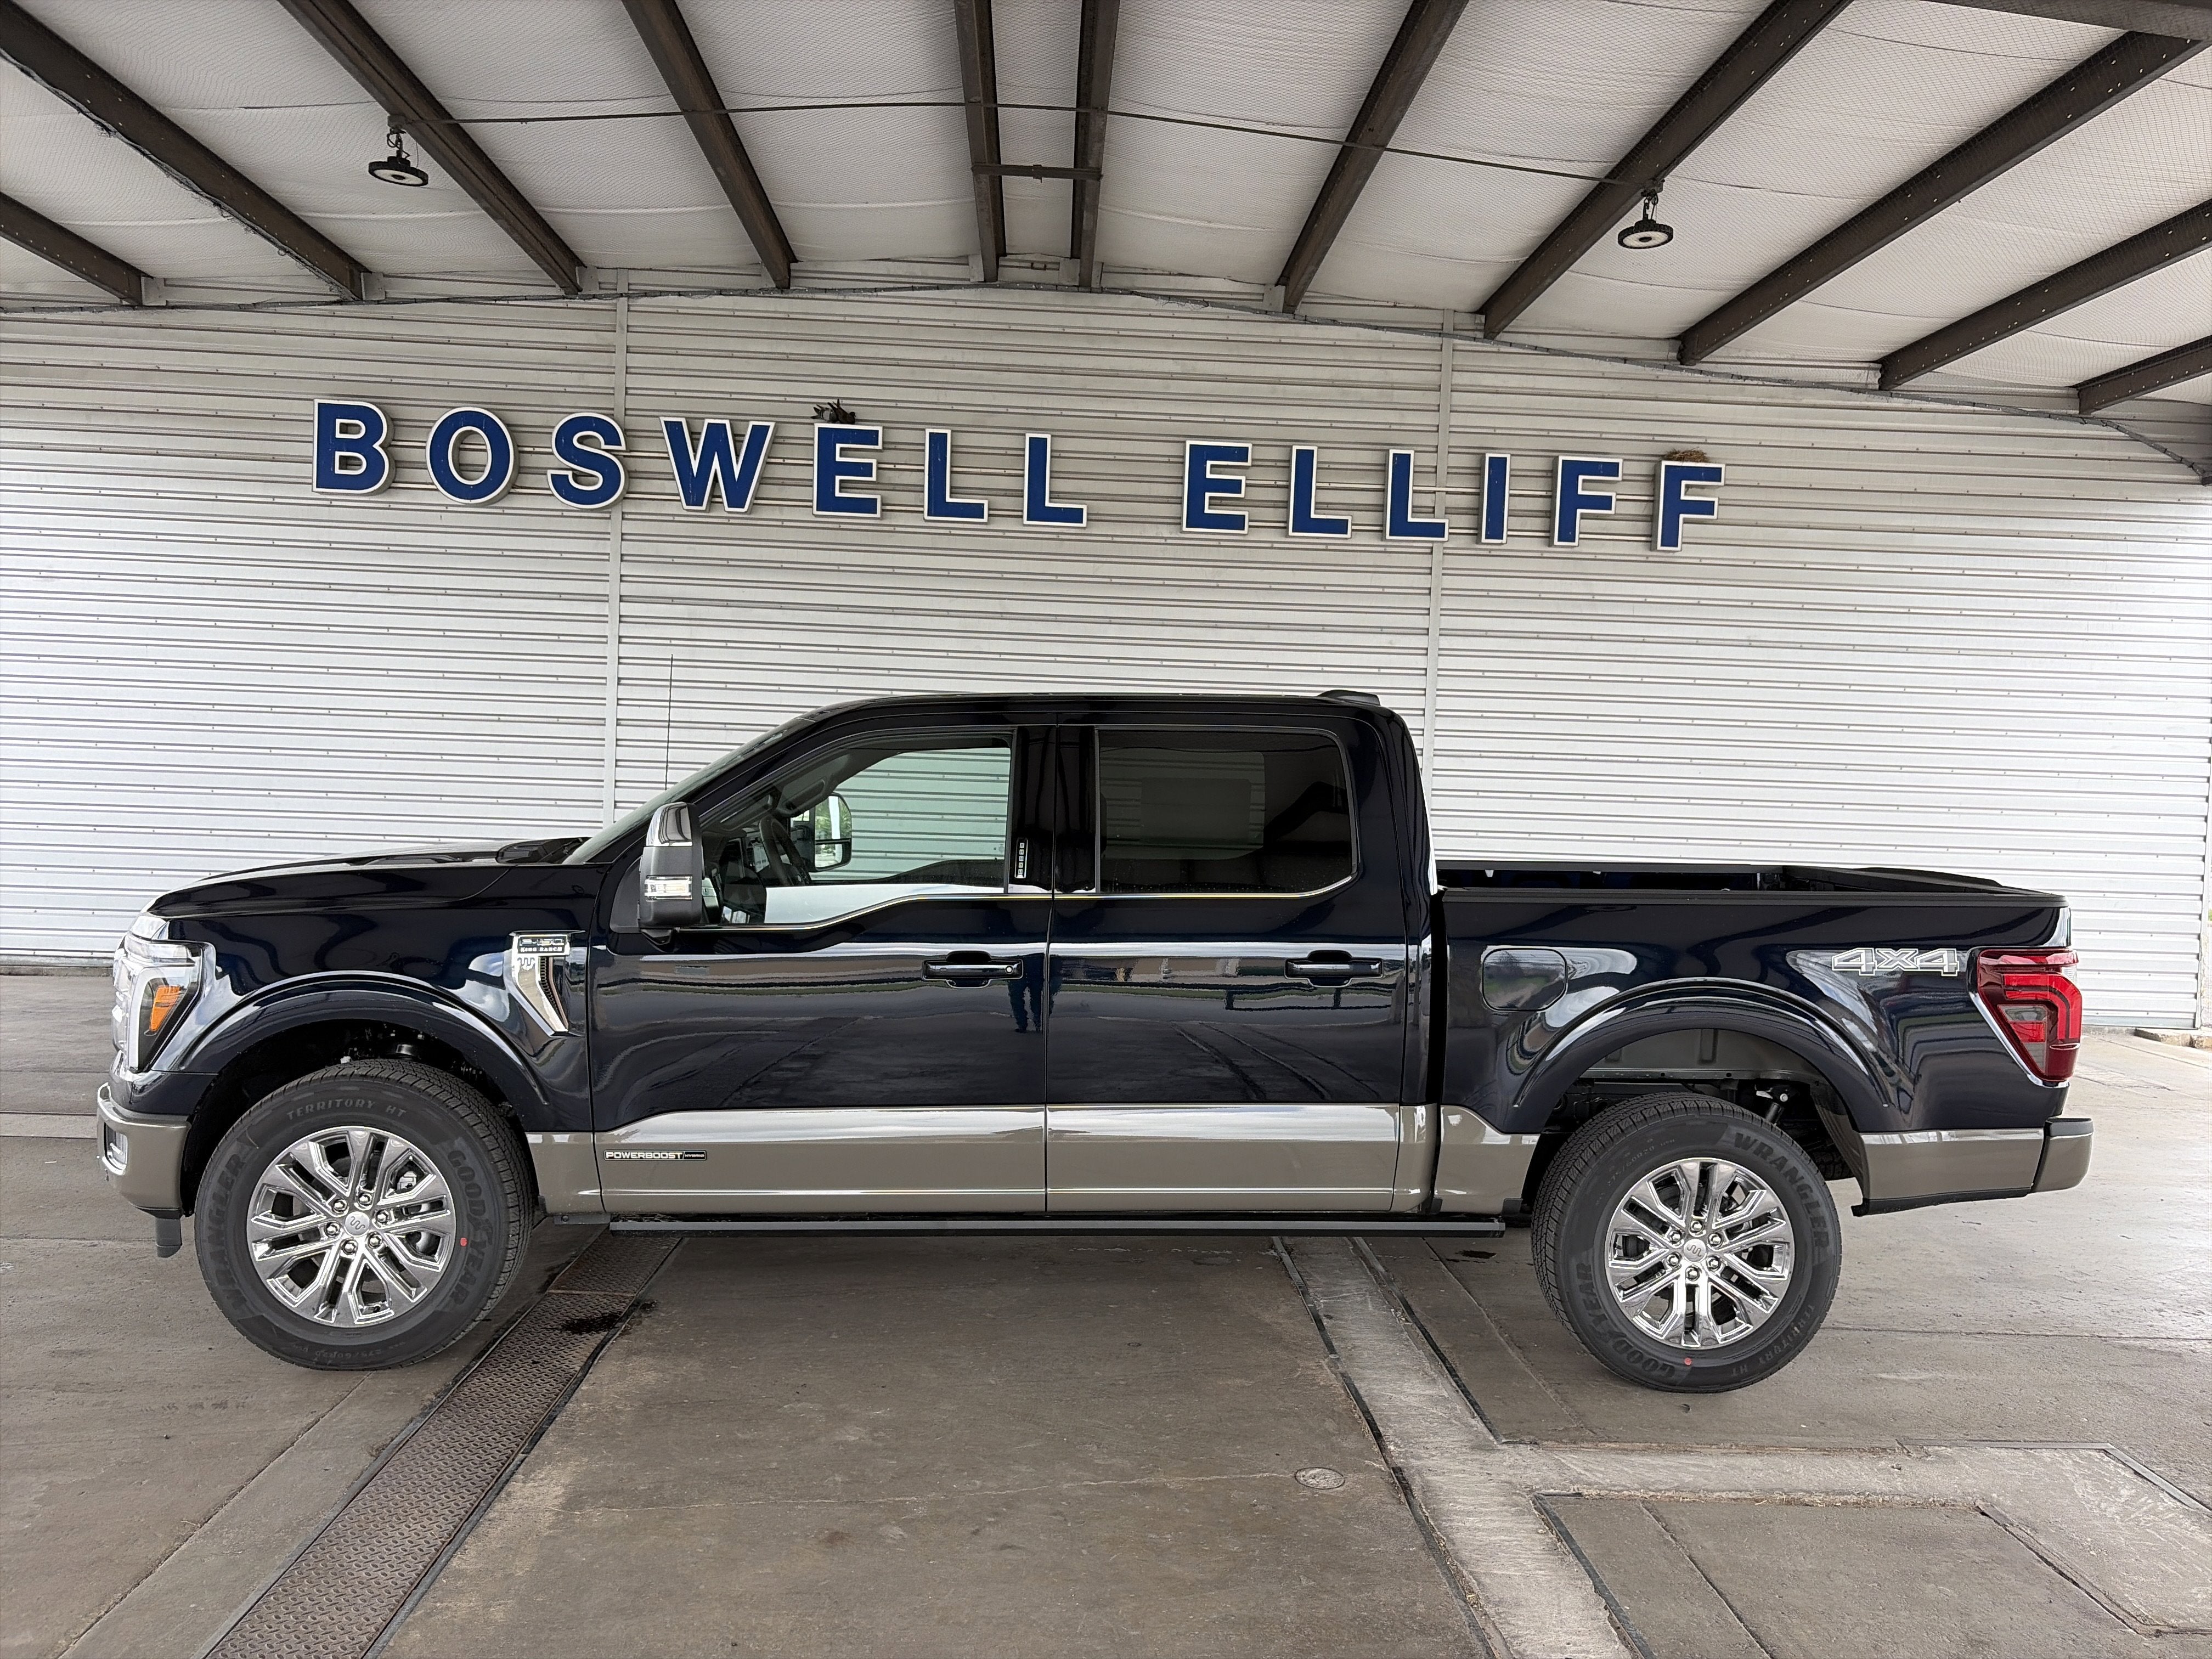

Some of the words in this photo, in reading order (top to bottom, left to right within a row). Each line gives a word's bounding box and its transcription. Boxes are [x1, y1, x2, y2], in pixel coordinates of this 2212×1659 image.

[312, 398, 1088, 528] BOSWELL
[1181, 439, 1726, 552] ELLIFF
[286, 1098, 376, 1120] TERRITORY
[385, 1104, 407, 1118] HT
[447, 1150, 494, 1306] GOODYEAR
[1734, 1132, 1830, 1249] WRANGLER
